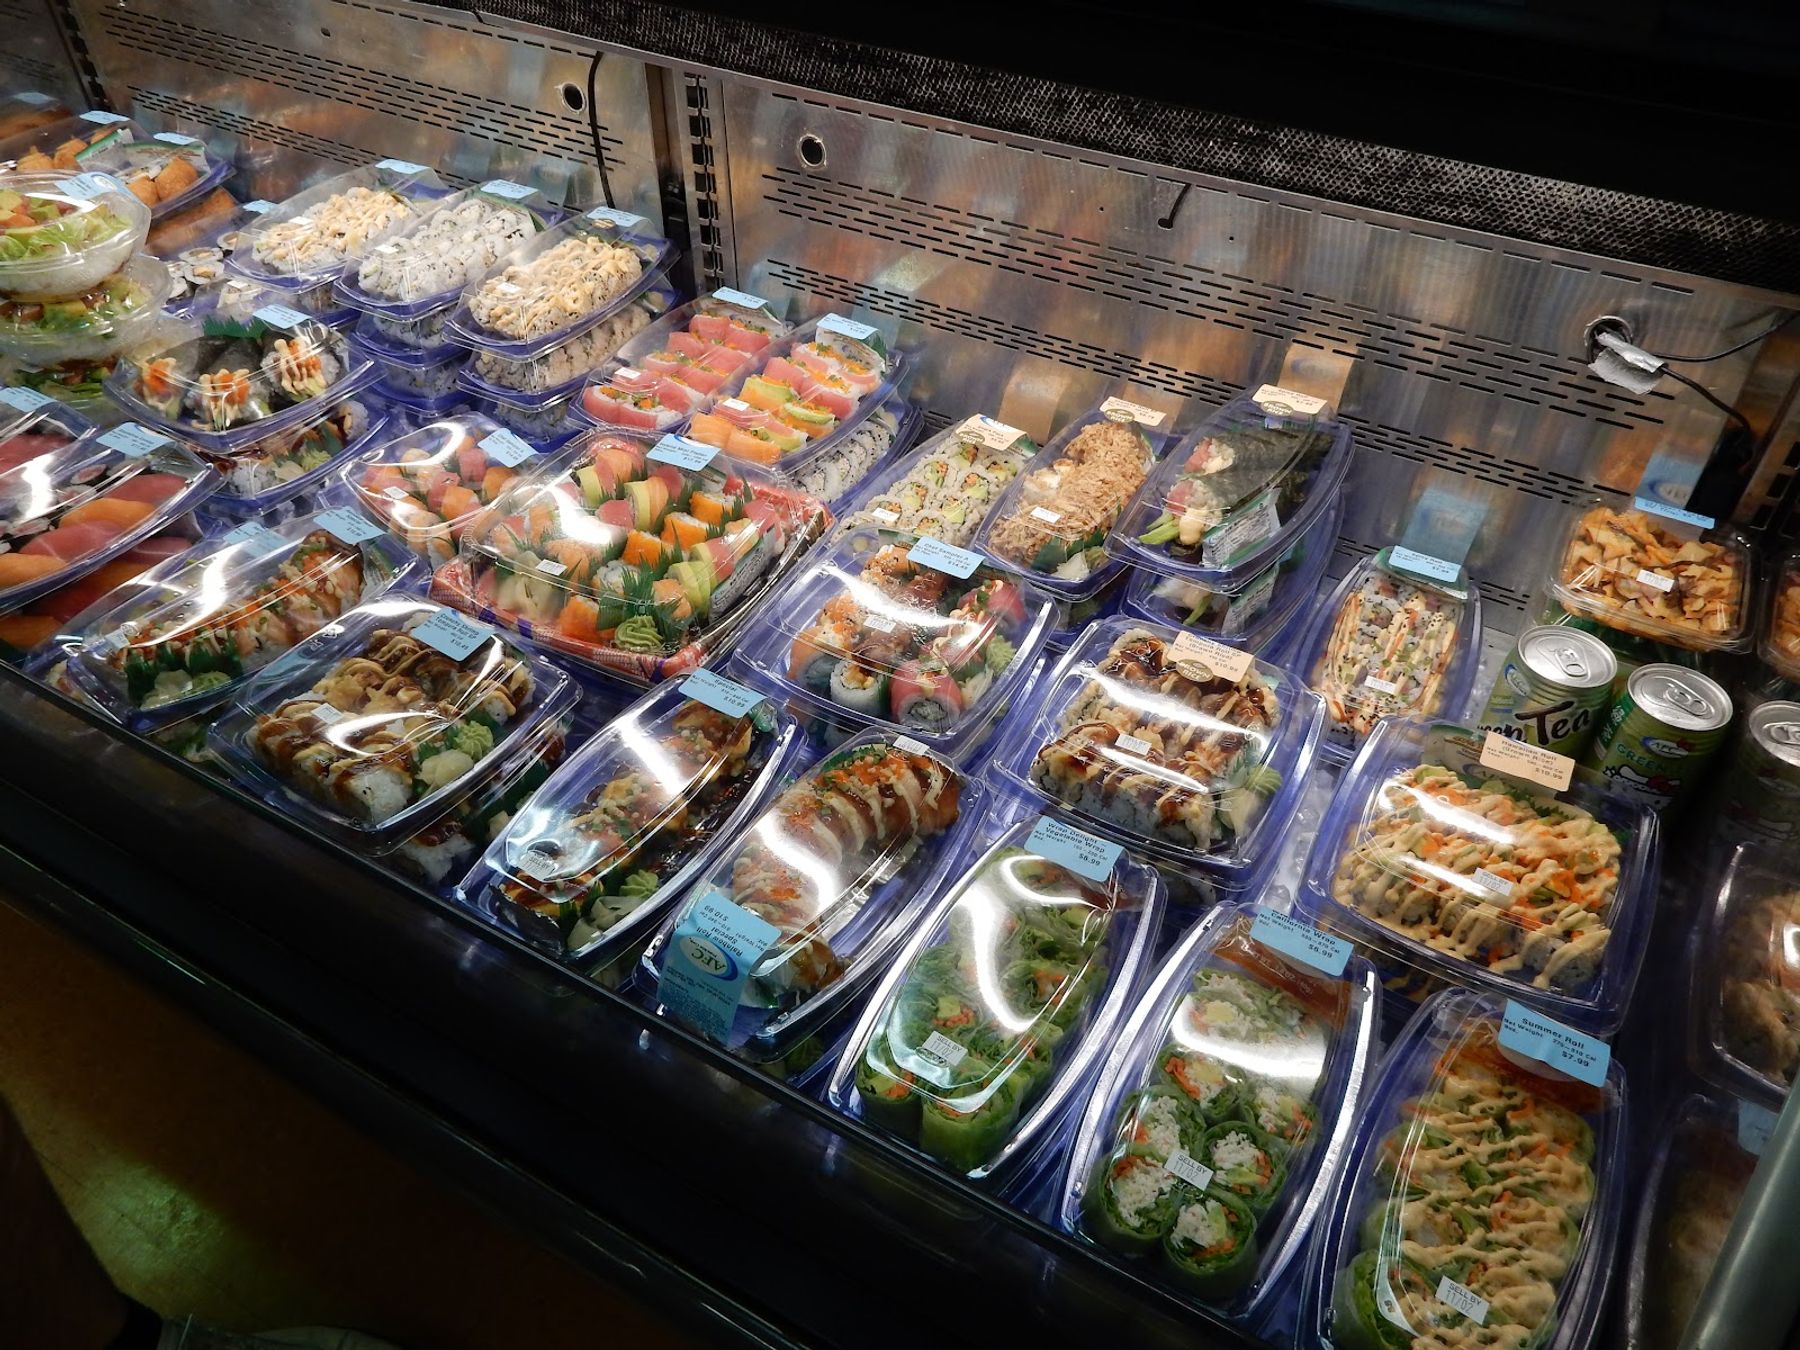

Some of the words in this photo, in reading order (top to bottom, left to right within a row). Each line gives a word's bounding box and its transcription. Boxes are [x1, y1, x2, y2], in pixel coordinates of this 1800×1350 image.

[938, 547, 962, 558] Sampler
[1514, 700, 1590, 746] Tea
[1045, 826, 1082, 844] Vegetable
[1084, 840, 1104, 853] Wrap
[1047, 822, 1067, 832] Wrap
[1069, 829, 1097, 844] Delight
[1078, 853, 1100, 866] $6.99
[704, 905, 729, 922] $10.99
[711, 926, 738, 945] Special
[1270, 912, 1310, 933] California
[1313, 930, 1335, 945] Wrap
[712, 935, 743, 957] Rainbow
[1308, 943, 1332, 958] $6.99
[691, 948, 726, 972] AFC
[1516, 1023, 1543, 1037] Weight
[1522, 1017, 1561, 1039] Summer
[1564, 1036, 1584, 1049] Roll
[929, 1040, 953, 1058] 11/02
[936, 1035, 955, 1048] SELL
[951, 1044, 962, 1052] BY
[1561, 1050, 1589, 1067] $7.99
[1173, 1160, 1198, 1181] 11/02
[1177, 1154, 1195, 1168] SELL
[1195, 1165, 1207, 1174] BY
[1445, 1289, 1473, 1314] 11/02
[1448, 1282, 1468, 1299] SELL
[1469, 1295, 1481, 1305] BY
